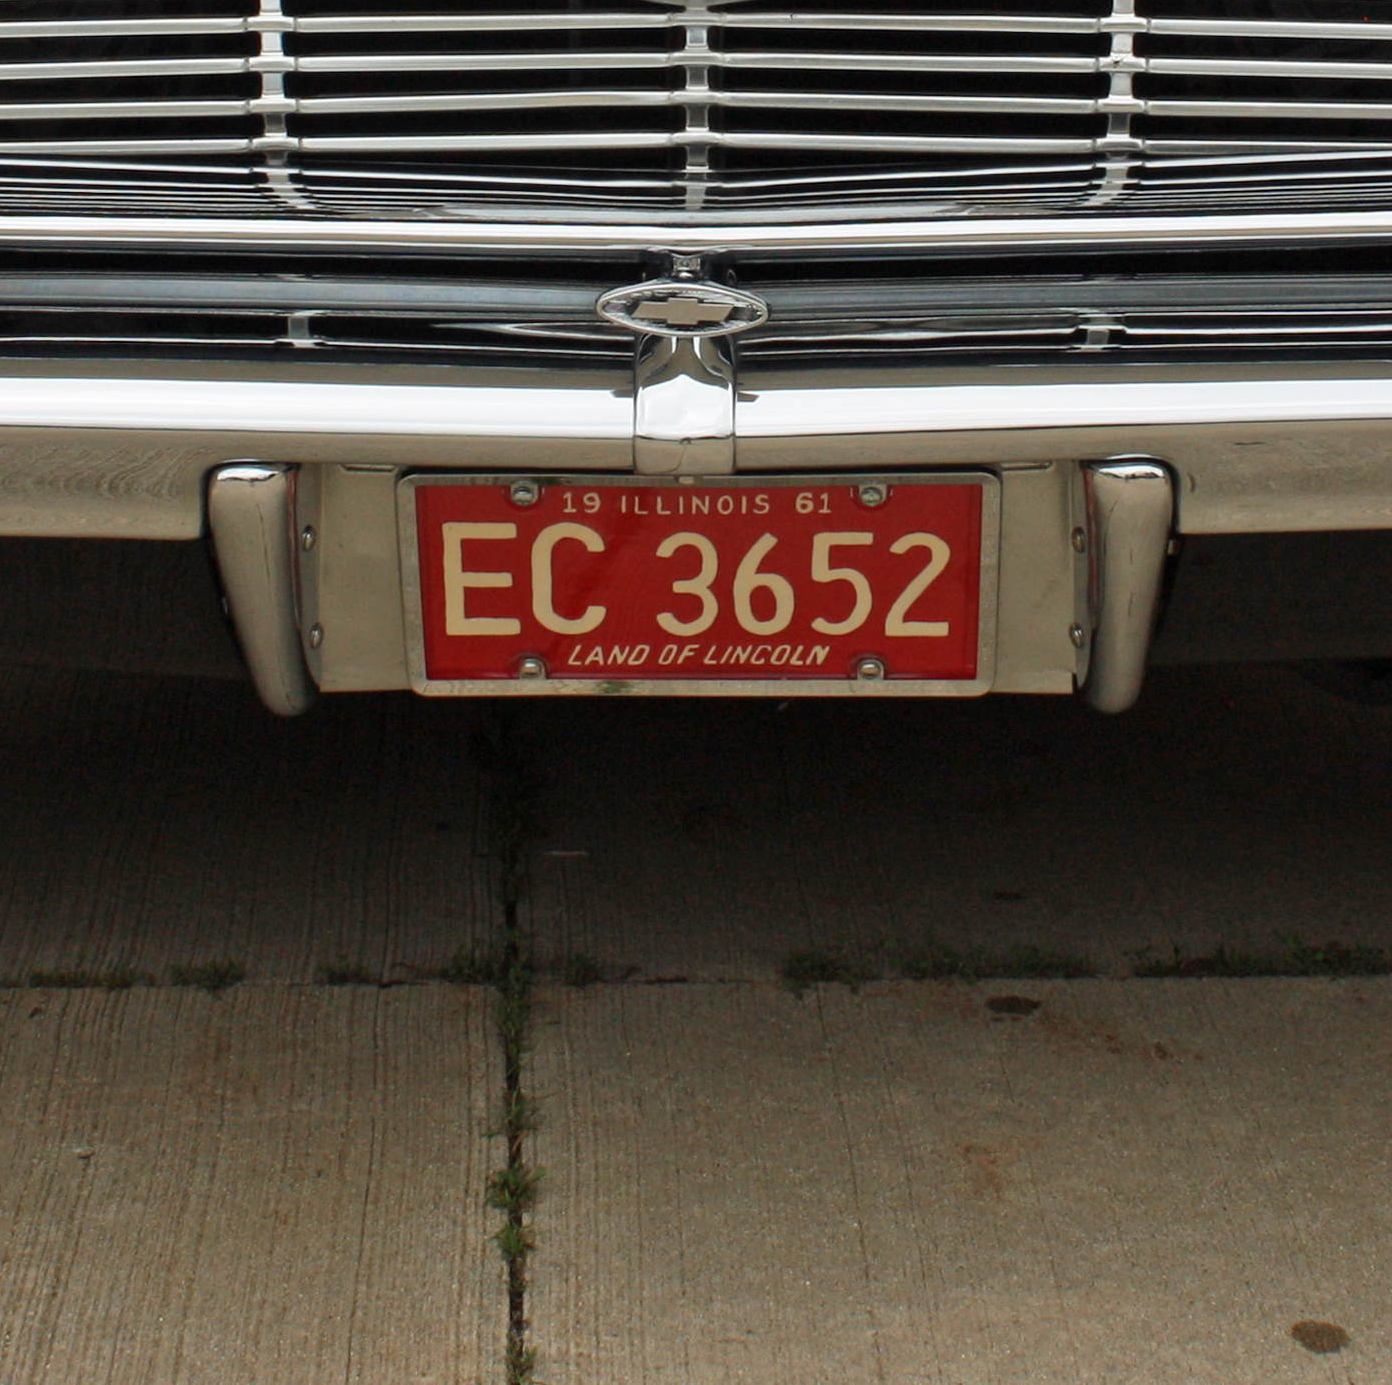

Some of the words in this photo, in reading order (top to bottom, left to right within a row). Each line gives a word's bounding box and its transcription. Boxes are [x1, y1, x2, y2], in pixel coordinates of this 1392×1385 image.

[562, 491, 601, 514] 19
[620, 494, 770, 515] ILLINOIS
[795, 491, 832, 514] 61
[440, 521, 608, 637] EC
[654, 530, 951, 638] 3652
[567, 644, 651, 666] LAND
[657, 643, 700, 665] OF
[703, 644, 831, 666] LINCOLN
